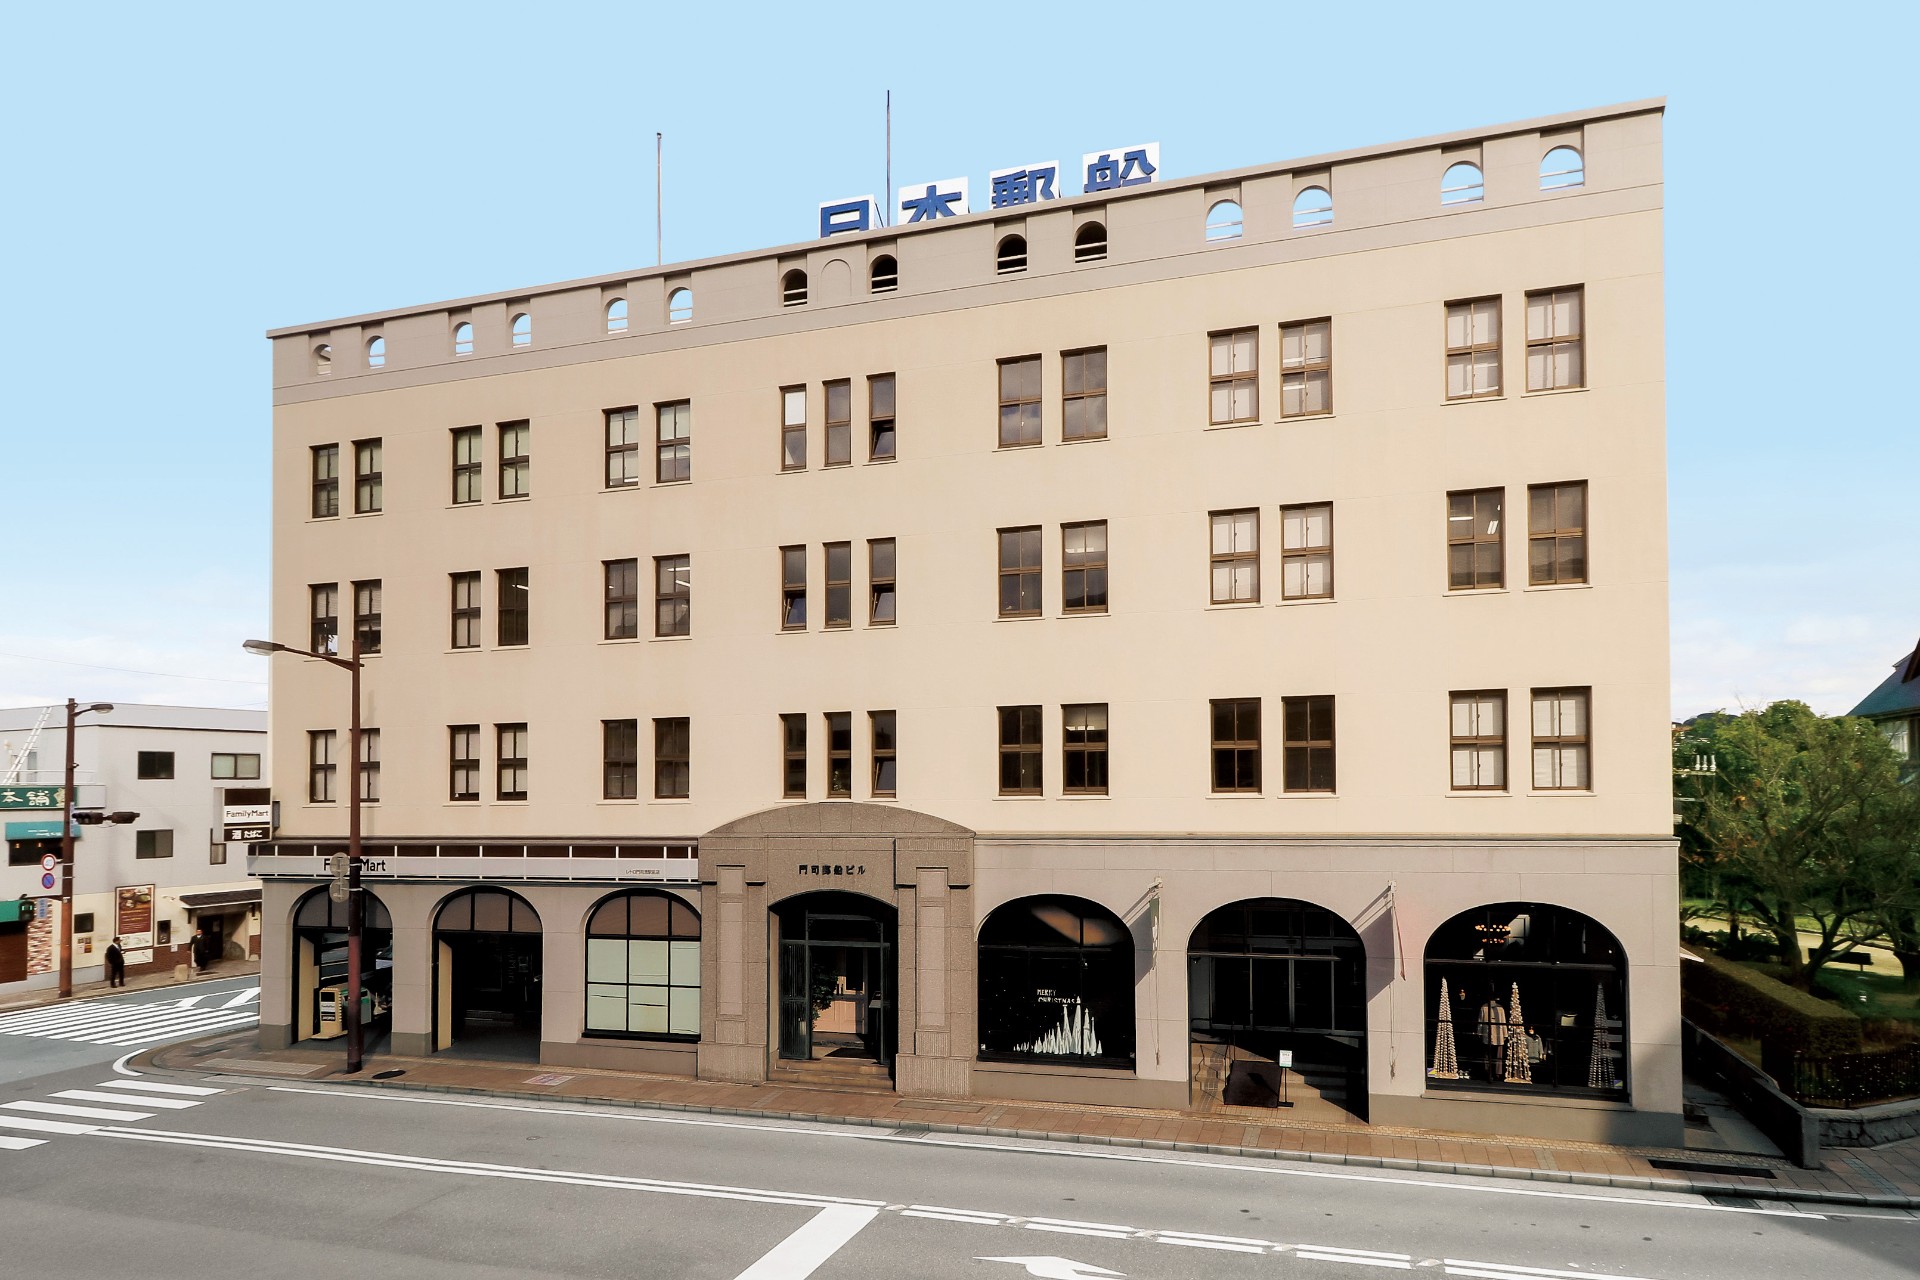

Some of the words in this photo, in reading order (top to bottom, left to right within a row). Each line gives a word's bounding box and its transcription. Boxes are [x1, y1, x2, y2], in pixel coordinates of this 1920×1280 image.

[226, 810, 269, 818] FamilyMart
[244, 830, 263, 838] たばこ
[799, 864, 866, 876] 門司郵船ビル
